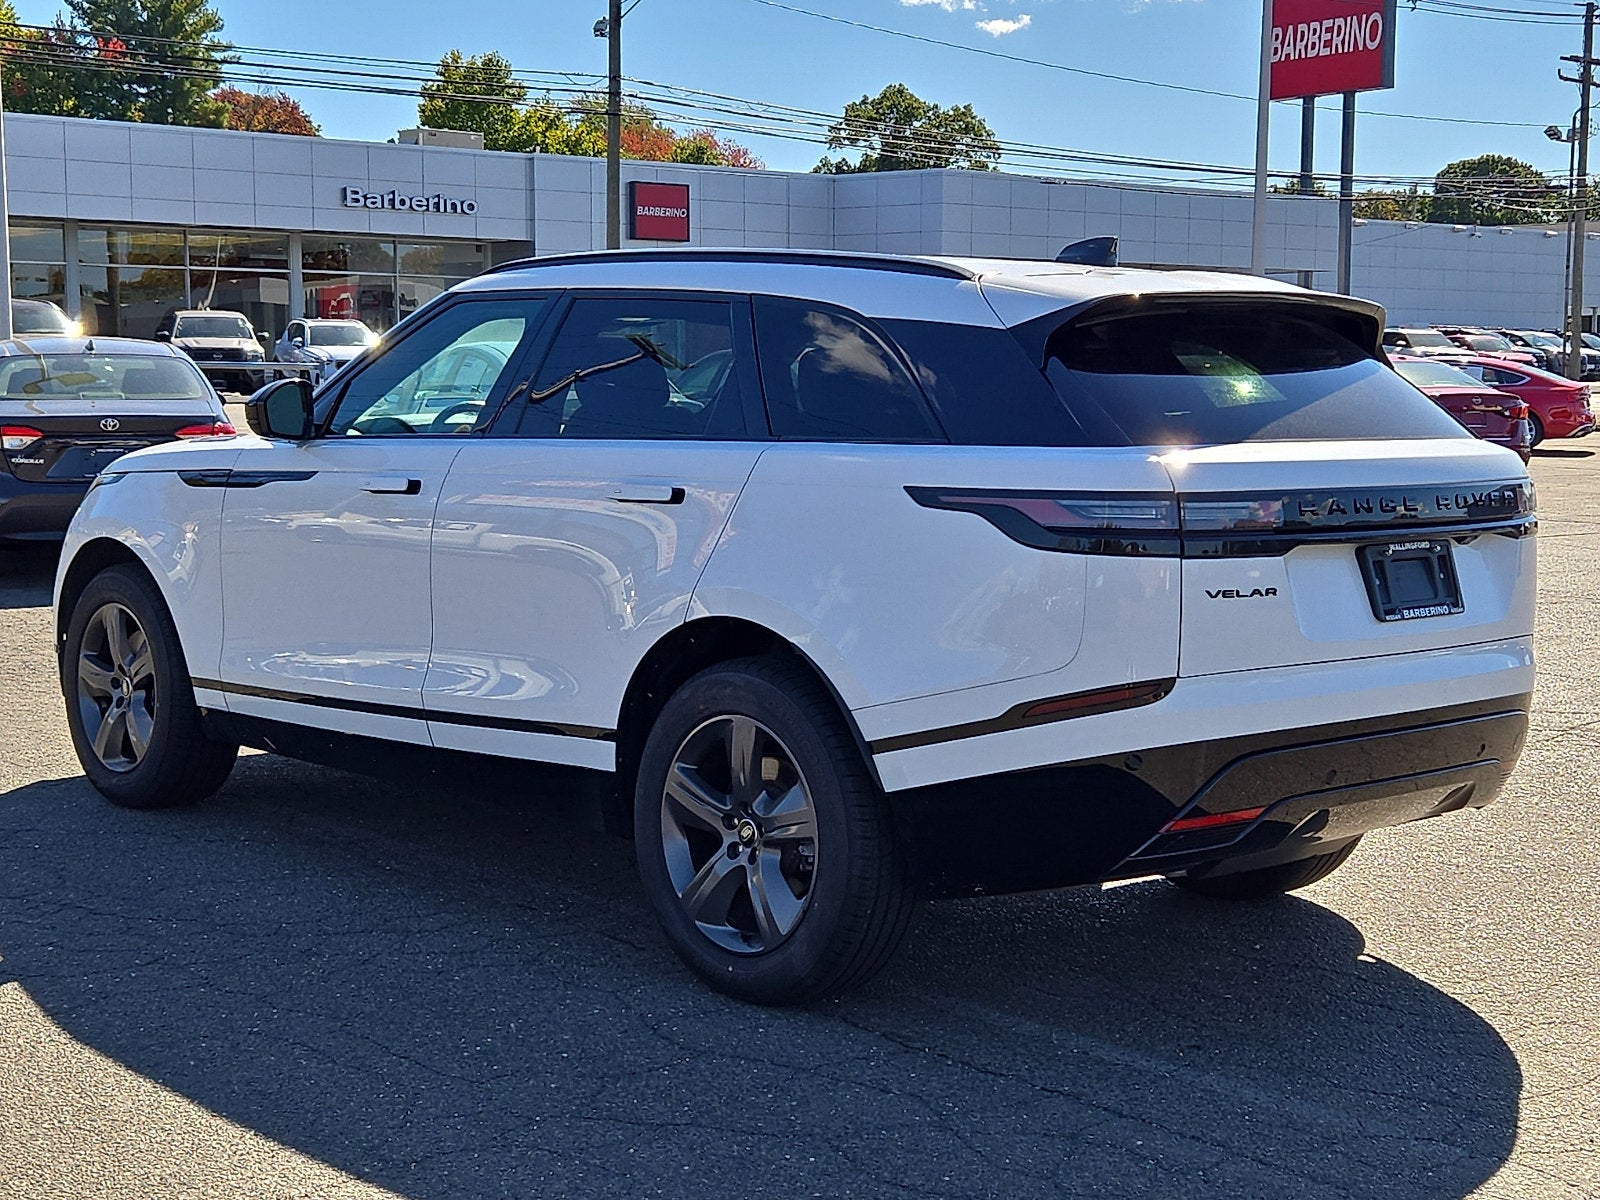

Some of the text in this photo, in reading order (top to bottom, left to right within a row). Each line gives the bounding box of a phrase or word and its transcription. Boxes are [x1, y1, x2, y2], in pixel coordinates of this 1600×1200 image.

[1270, 12, 1383, 63] BARBERINO
[344, 186, 479, 215] Barberino
[637, 205, 688, 218] BARBERINO
[1298, 490, 1515, 516] RANGE ROVER
[1205, 587, 1278, 599] VELAR
[1403, 605, 1449, 619] BARBERINO
